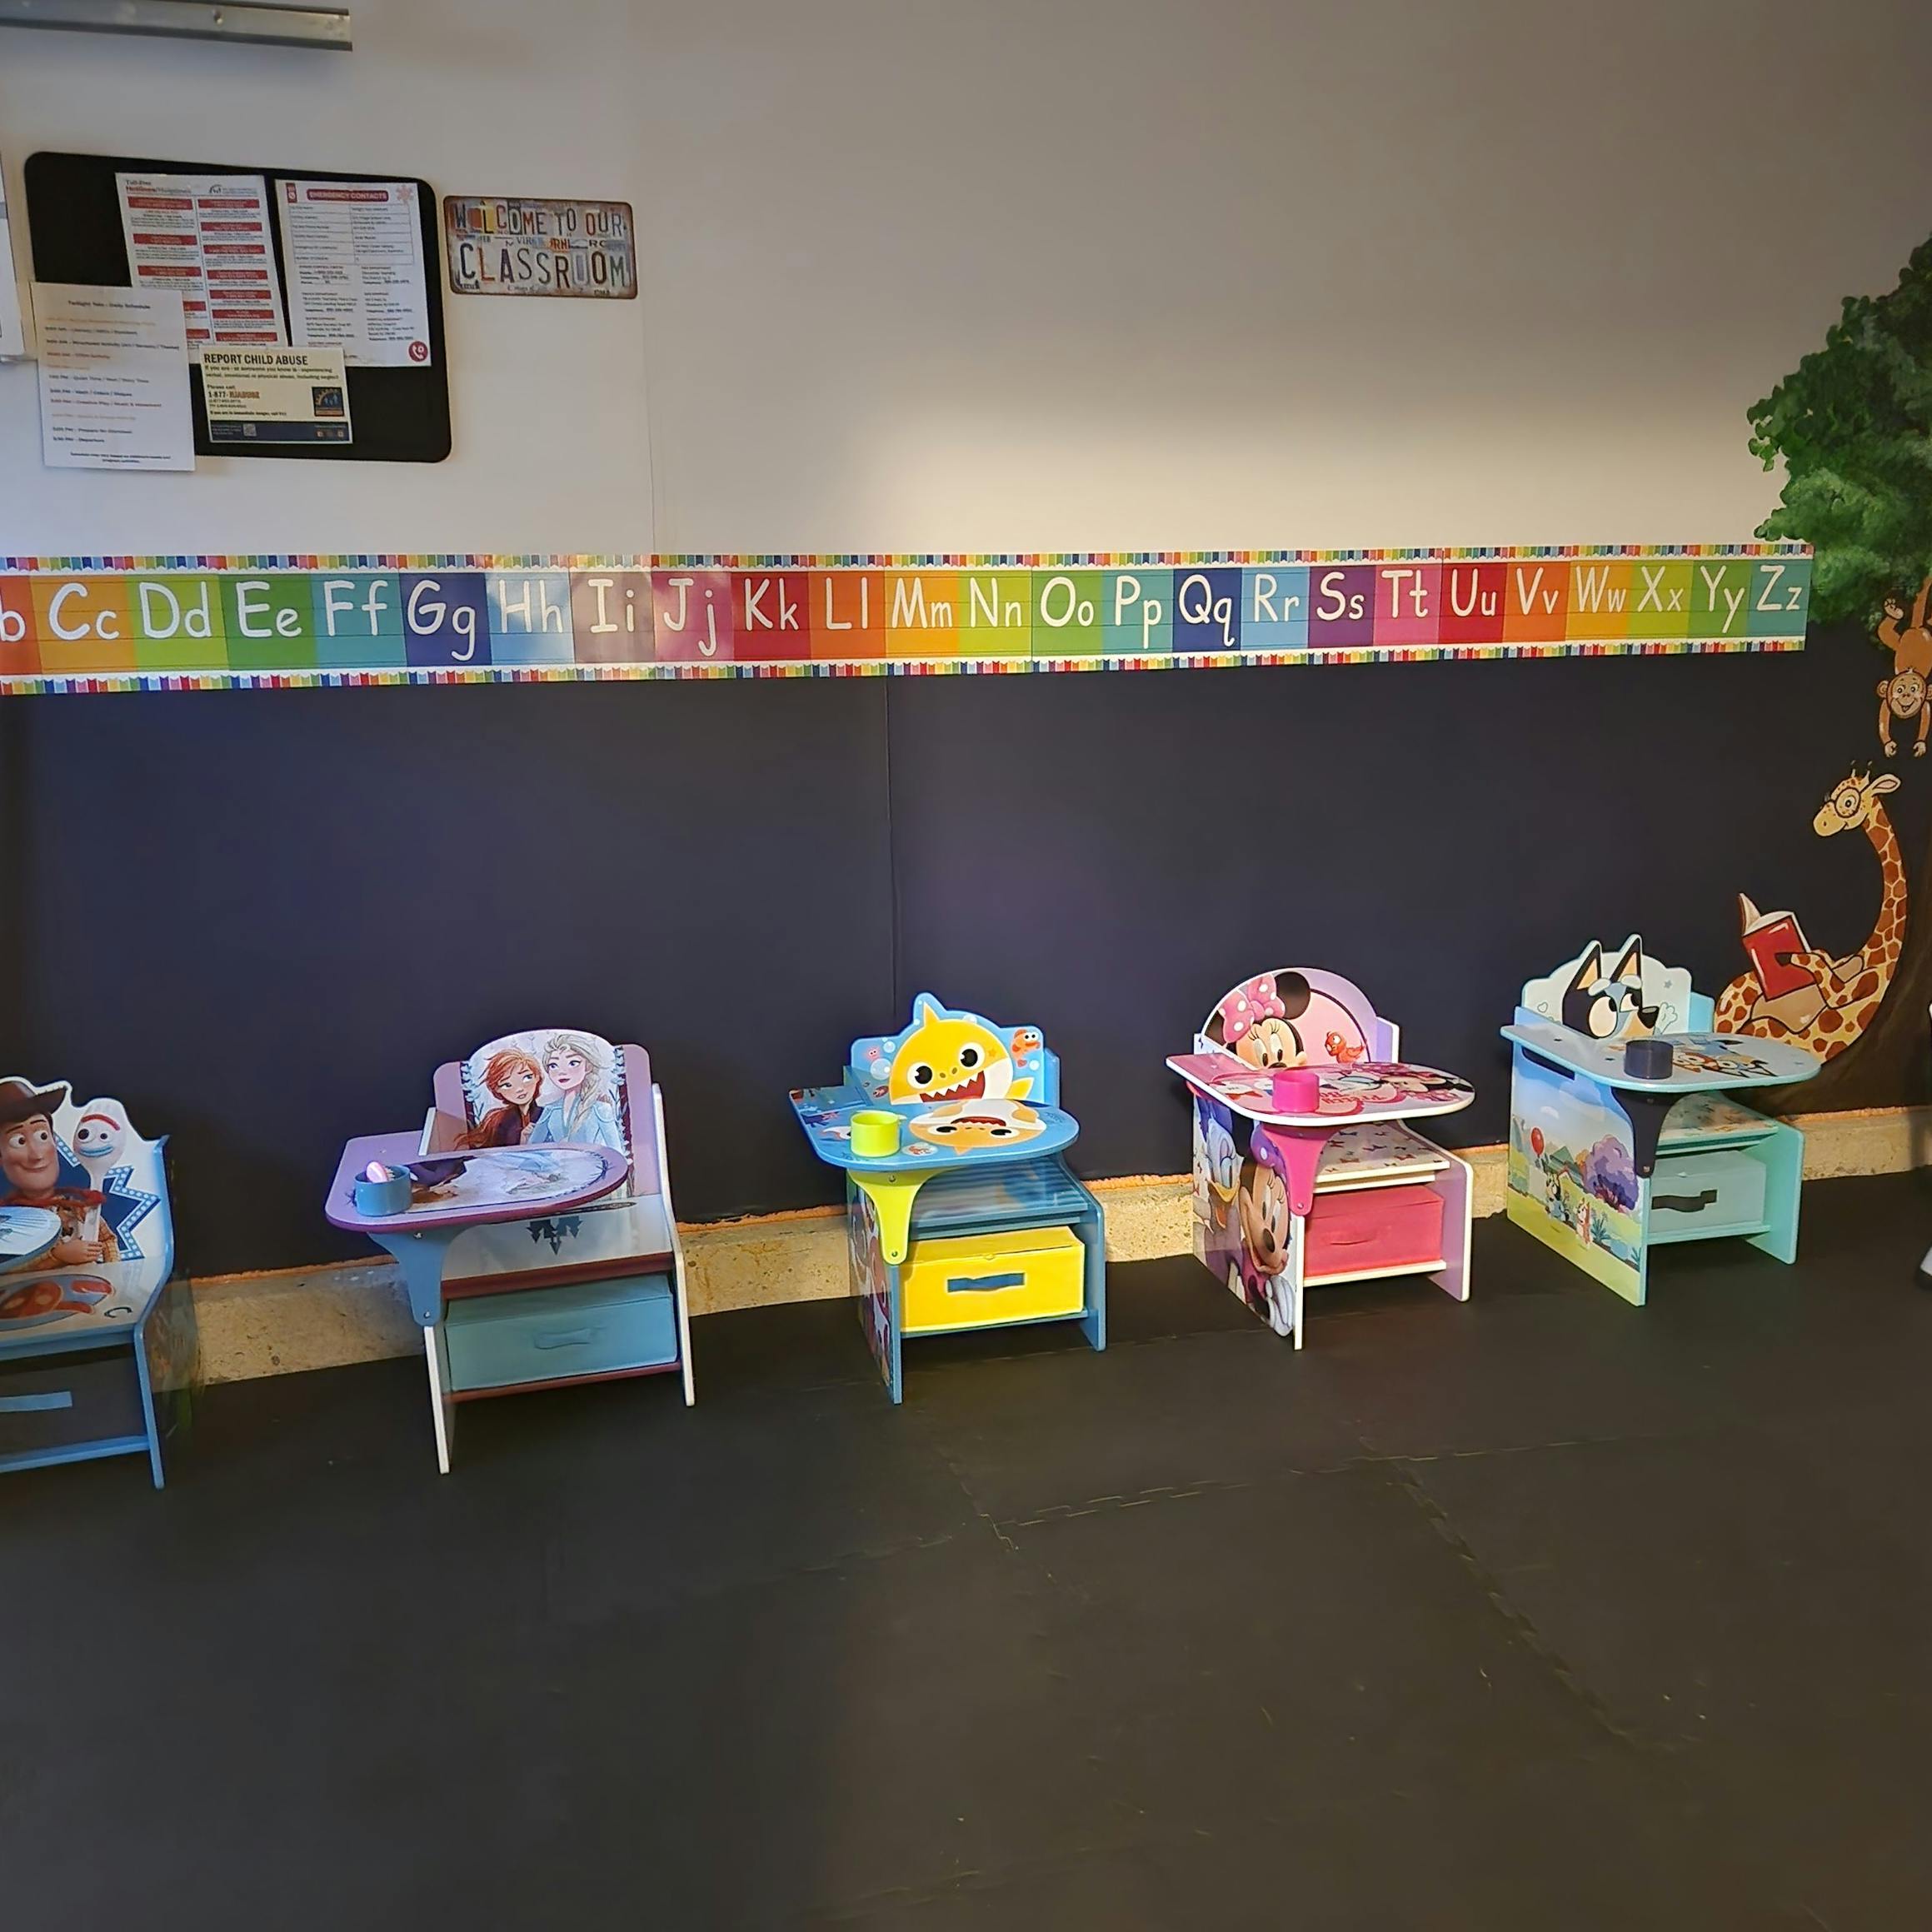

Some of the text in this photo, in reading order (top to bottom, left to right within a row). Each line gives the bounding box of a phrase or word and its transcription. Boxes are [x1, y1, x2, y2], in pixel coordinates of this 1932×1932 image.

[555, 207, 577, 237] TO
[586, 211, 622, 237] OUR
[203, 353, 308, 366] REPORT CHILD ABUSE
[48, 582, 120, 641] Cc
[138, 581, 212, 639] Dd
[235, 581, 302, 638] Ee
[323, 580, 388, 637] Ff
[407, 579, 476, 661] Gg
[499, 578, 563, 633] Hh
[587, 578, 635, 633] Ii
[663, 577, 717, 656] Jj
[744, 577, 799, 632] Kk
[826, 577, 868, 630] Ll
[891, 577, 953, 628] Mm
[969, 577, 1022, 627] Nn
[1040, 576, 1095, 627] Oo
[1115, 575, 1162, 650] Pp
[1179, 574, 1236, 647] Qq
[1254, 573, 1300, 622] Rr
[1316, 572, 1365, 621] Ss
[1381, 569, 1429, 618] Tt
[1451, 568, 1497, 617] Uu
[1516, 567, 1559, 615] Vv
[1575, 565, 1626, 613] Ww
[1637, 566, 1684, 612] Xx
[1700, 565, 1745, 634] Yy
[1756, 565, 1803, 612] Zz
